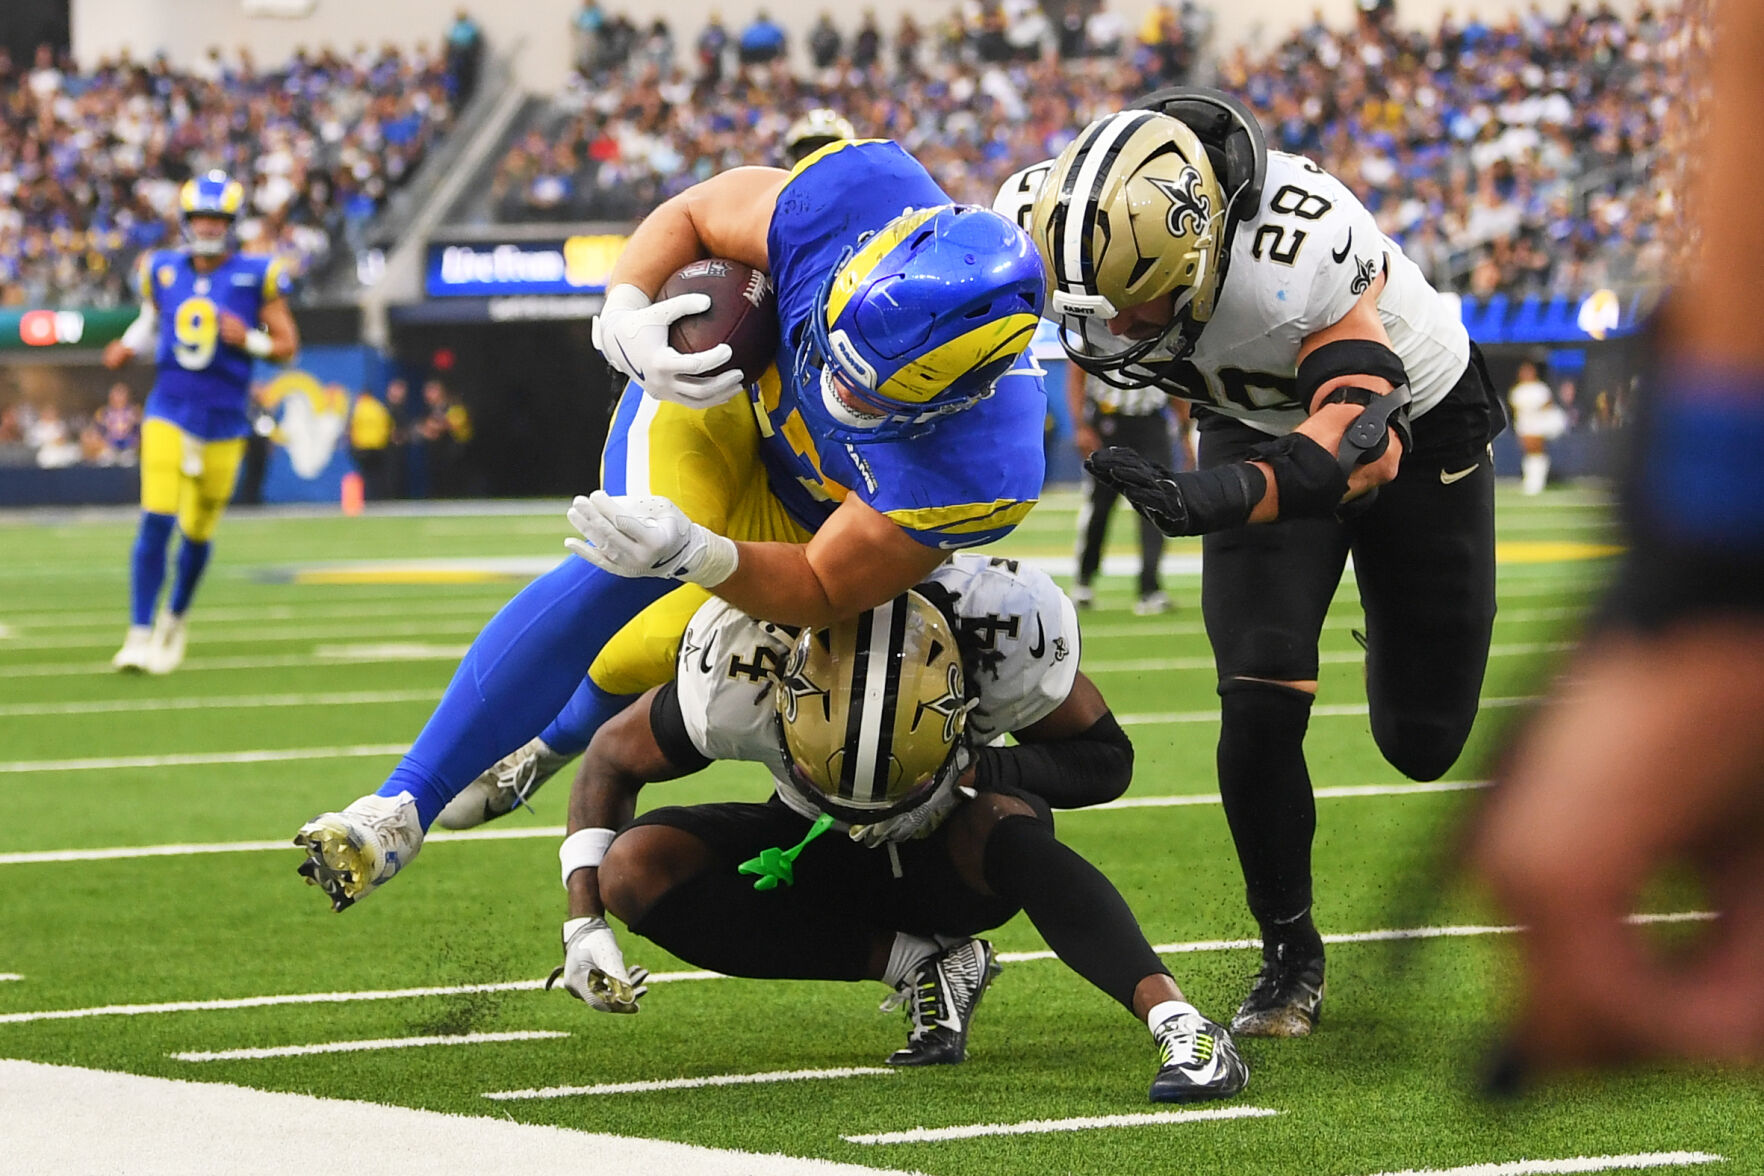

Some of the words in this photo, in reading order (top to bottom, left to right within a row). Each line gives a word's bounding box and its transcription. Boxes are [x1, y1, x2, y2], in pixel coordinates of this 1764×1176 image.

[1252, 184, 1333, 266] 28
[174, 296, 218, 372] 9
[1063, 304, 1095, 315] SAINTS
[844, 443, 877, 495] RAMS
